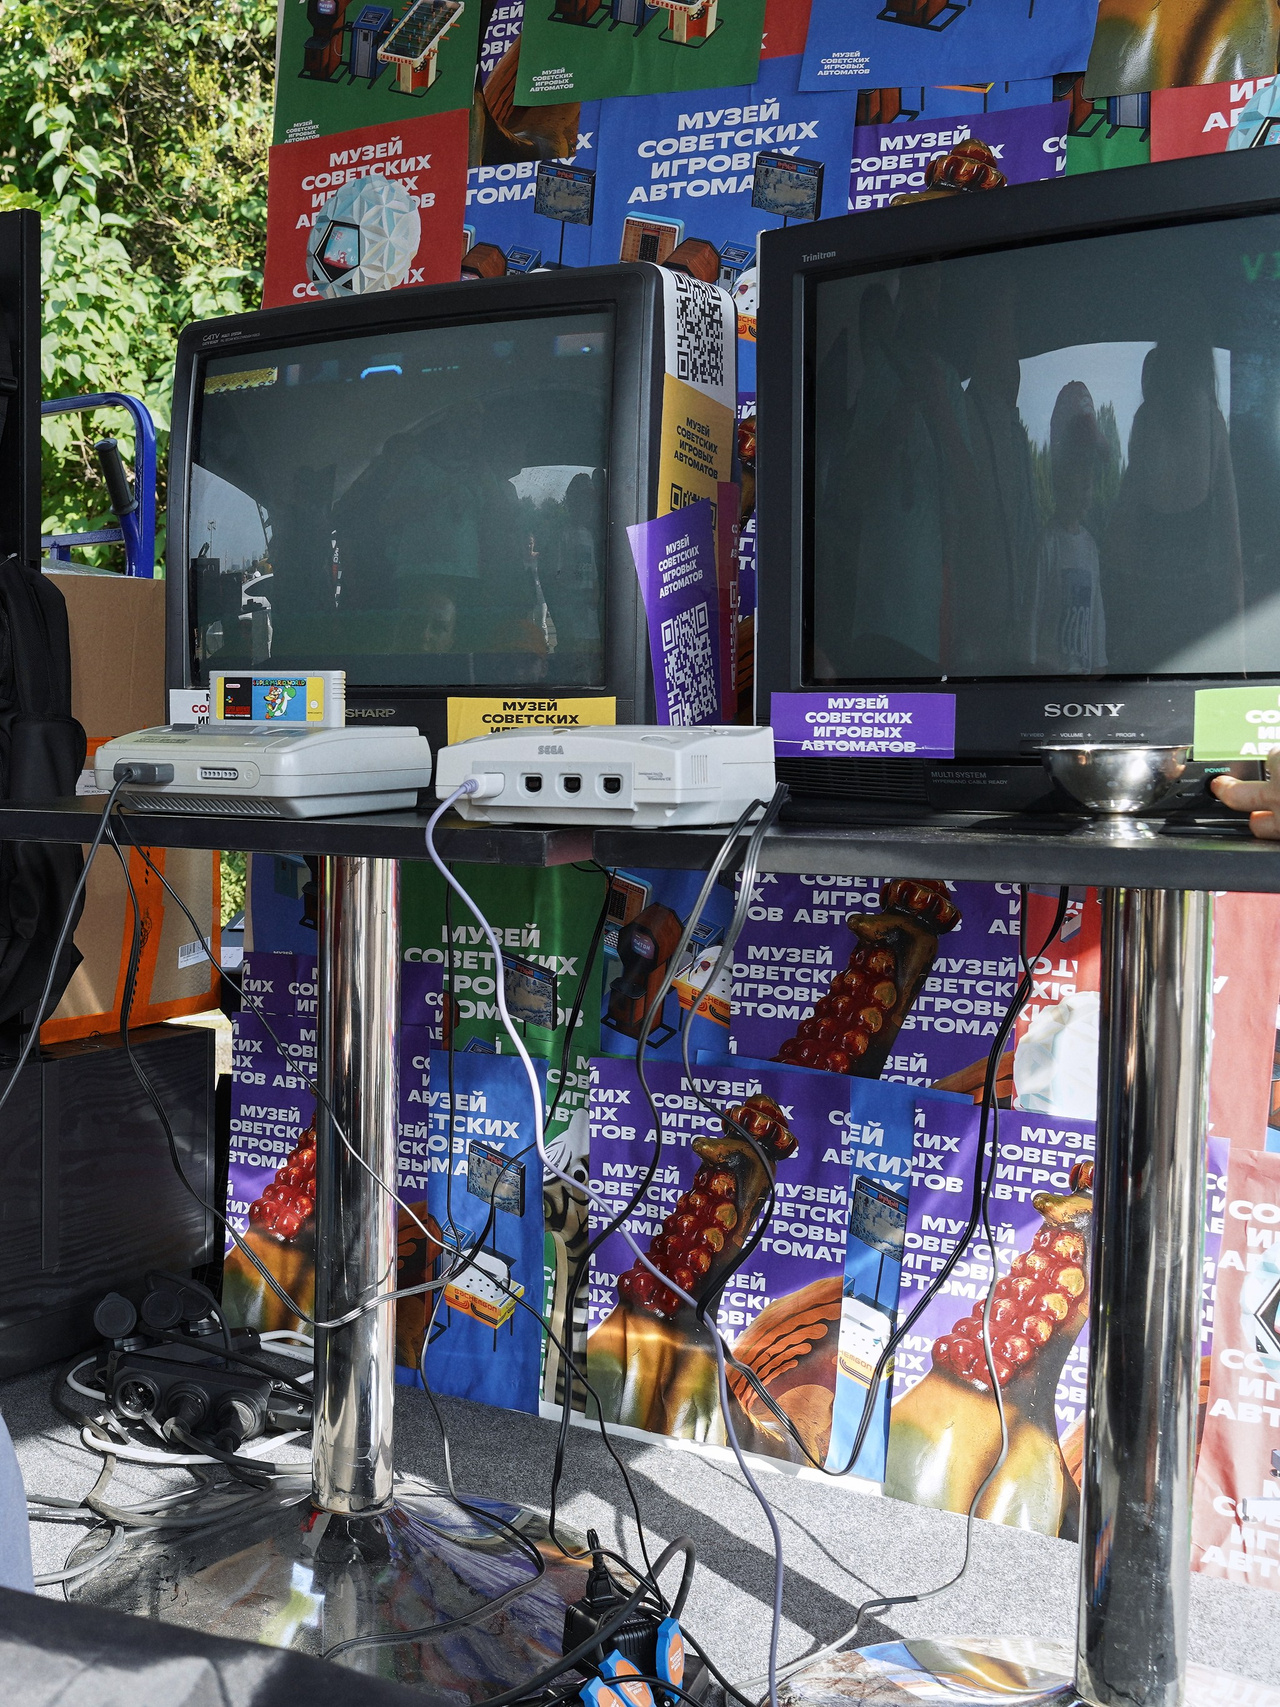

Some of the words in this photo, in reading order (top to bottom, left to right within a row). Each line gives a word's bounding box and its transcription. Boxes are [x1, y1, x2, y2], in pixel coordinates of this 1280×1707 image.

[490, 1, 524, 22] ЗЕЙ
[532, 72, 574, 82] СОВЕТСКИХ
[542, 67, 566, 76] МУЗЕЙ
[817, 68, 870, 76] АВТОМАТОВ
[529, 83, 574, 92] АВТОМАТОВ
[535, 78, 570, 87] ИГРОВЫХ
[677, 97, 780, 132] МУЗЕЙ
[285, 124, 320, 134] СОВЕТСКИХ
[637, 120, 819, 158] СОВЕТСКИХ
[879, 124, 971, 151] МУЗЕЙ
[329, 136, 403, 167] МУЗЕЙ
[301, 154, 432, 191] СОВЕТСКИХ
[651, 146, 801, 179] ИГРОВ
[627, 174, 754, 204] АВТОМА
[856, 171, 925, 191] ИГРО
[802, 249, 837, 263] Trinitron
[686, 417, 710, 438] МУЗЕЙ
[676, 425, 718, 455] СОВЕТСКИХ
[679, 439, 714, 466] ИГРОВЫХ
[673, 450, 719, 480] АВТОМАТОВ
[665, 534, 690, 556] МУЗЕЙ
[658, 545, 700, 572] СОВЕТСКИХ
[662, 559, 697, 584] ИГРОВЫХ
[659, 570, 703, 599] АВТОМАТОВ
[502, 698, 558, 711] МУЗЕЙ
[827, 694, 889, 710] МУЗЕЙ
[1044, 703, 1125, 718] SONY
[345, 708, 396, 718] SHARP
[481, 713, 580, 725] СОВЕТСКИХ
[804, 712, 913, 725] СОВЕТСКИХ
[813, 726, 902, 739] ИГРОВЫХ
[538, 745, 564, 755] SEGA
[801, 739, 917, 753] АВТОМАТОВ
[812, 890, 880, 908] ИГРО
[442, 923, 540, 948] МУЗЕЙ
[747, 945, 833, 965] МУЗЕЙ
[732, 963, 840, 985] ОВЕТСК
[932, 957, 1016, 978] МУЗЕЙ
[921, 976, 1018, 998] ВЕТСК
[680, 1076, 762, 1096] МУЗЕЙ
[429, 1090, 487, 1113] УЗЕЙ
[240, 1104, 300, 1124] МУЗЕЙ
[661, 1112, 723, 1132] ИГРО
[1021, 1126, 1096, 1149] МУЗЕ
[602, 1162, 680, 1185] МУЗЕЙ
[996, 1163, 1070, 1188] ИГРО
[771, 1183, 847, 1205] МУЗЕЙ
[754, 1220, 847, 1244] ГРОВЫ
[921, 1214, 1016, 1244] МУЗЕЙ
[760, 1237, 846, 1264] ТОМАТ
